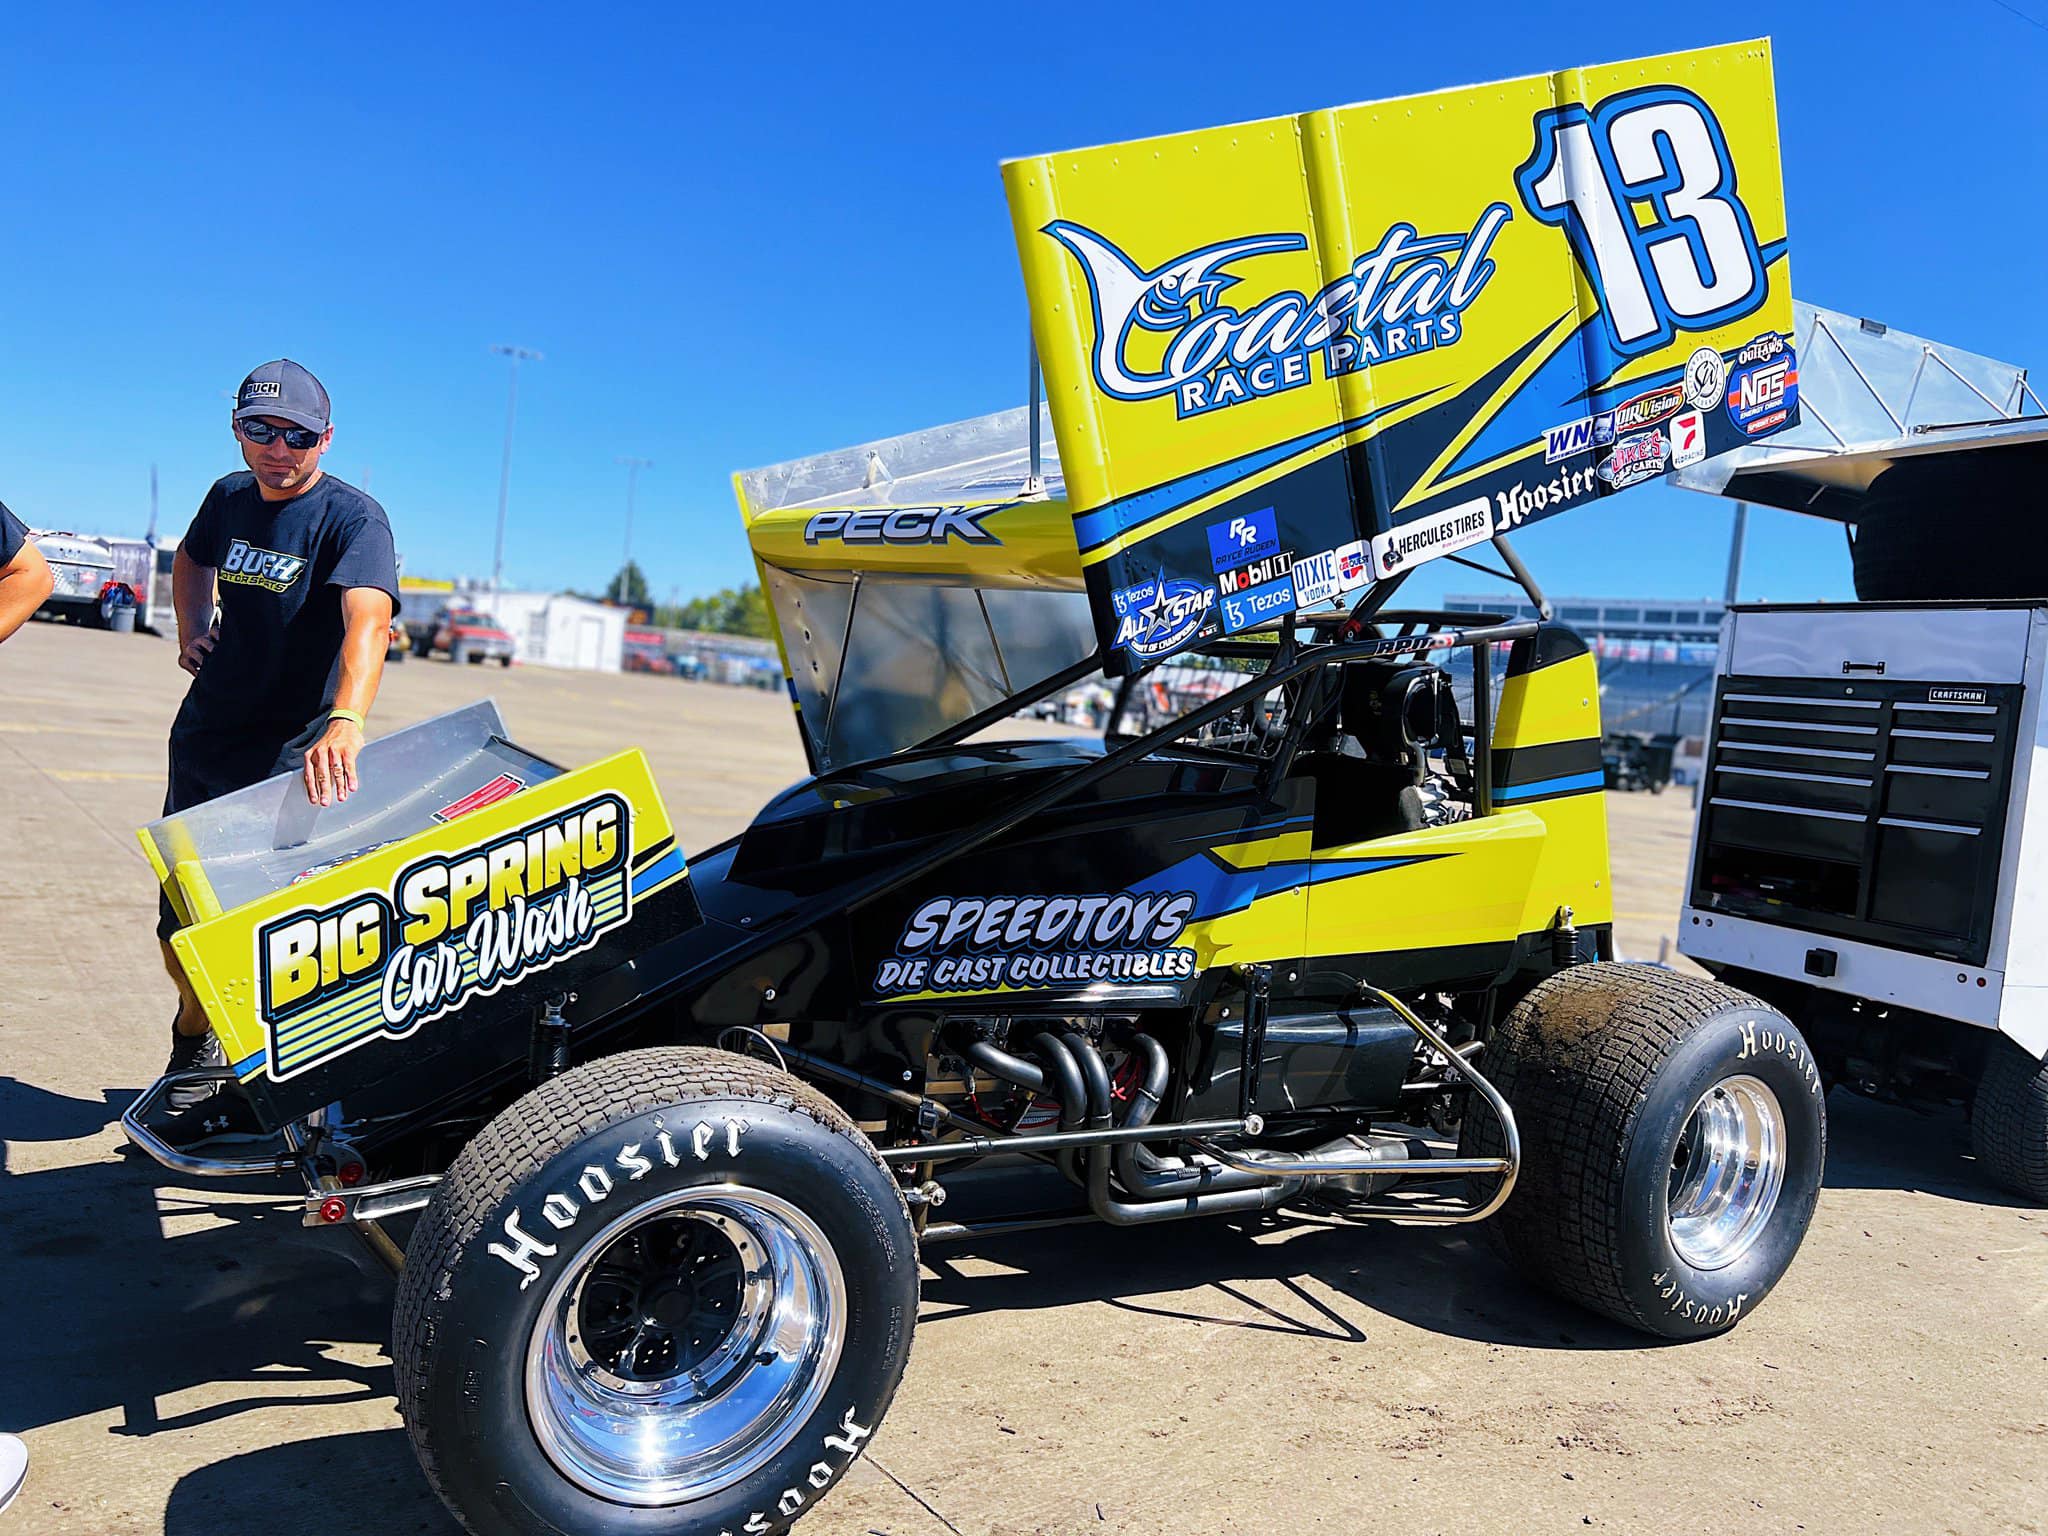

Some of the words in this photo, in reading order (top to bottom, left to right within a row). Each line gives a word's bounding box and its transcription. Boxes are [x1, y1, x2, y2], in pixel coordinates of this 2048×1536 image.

[1516, 86, 1767, 356] 13
[1041, 203, 1512, 401] Coastal
[1179, 353, 1308, 418] RACE
[1327, 312, 1462, 377] PARTS
[1740, 356, 1790, 411] NOS
[1632, 459, 1662, 474] CARTS
[1495, 465, 1595, 531] Hoosier
[804, 503, 1016, 545] PECK
[1229, 517, 1257, 547] RR
[1399, 523, 1453, 556] HERCULES
[1454, 510, 1485, 536] TIRES
[224, 543, 306, 582] BUCH
[1215, 549, 1243, 565] RAYCE
[1244, 538, 1276, 556] RUDEEN
[1294, 552, 1335, 591] DIXIE
[1126, 585, 1154, 604] Tezos
[1219, 558, 1273, 595] Mobil
[1304, 584, 1332, 602] VODKA
[1116, 615, 1148, 645] ALL
[1170, 588, 1214, 627] STAR
[1246, 588, 1291, 614] Tezos
[1932, 690, 1982, 700] CRAFTSMAN
[266, 902, 382, 1010] BIG
[402, 801, 617, 947] SPRING
[903, 895, 1193, 950] SPEEDTOYS
[380, 944, 463, 1025] Car
[463, 877, 595, 975] Wash
[877, 960, 926, 988] DIE
[933, 956, 1006, 984] CAST
[1009, 949, 1195, 982] COLLECTIBLES
[1736, 1020, 1822, 1095] Hoosier
[487, 1116, 749, 1292] Hoosier
[1651, 1267, 1749, 1326] Hoosier
